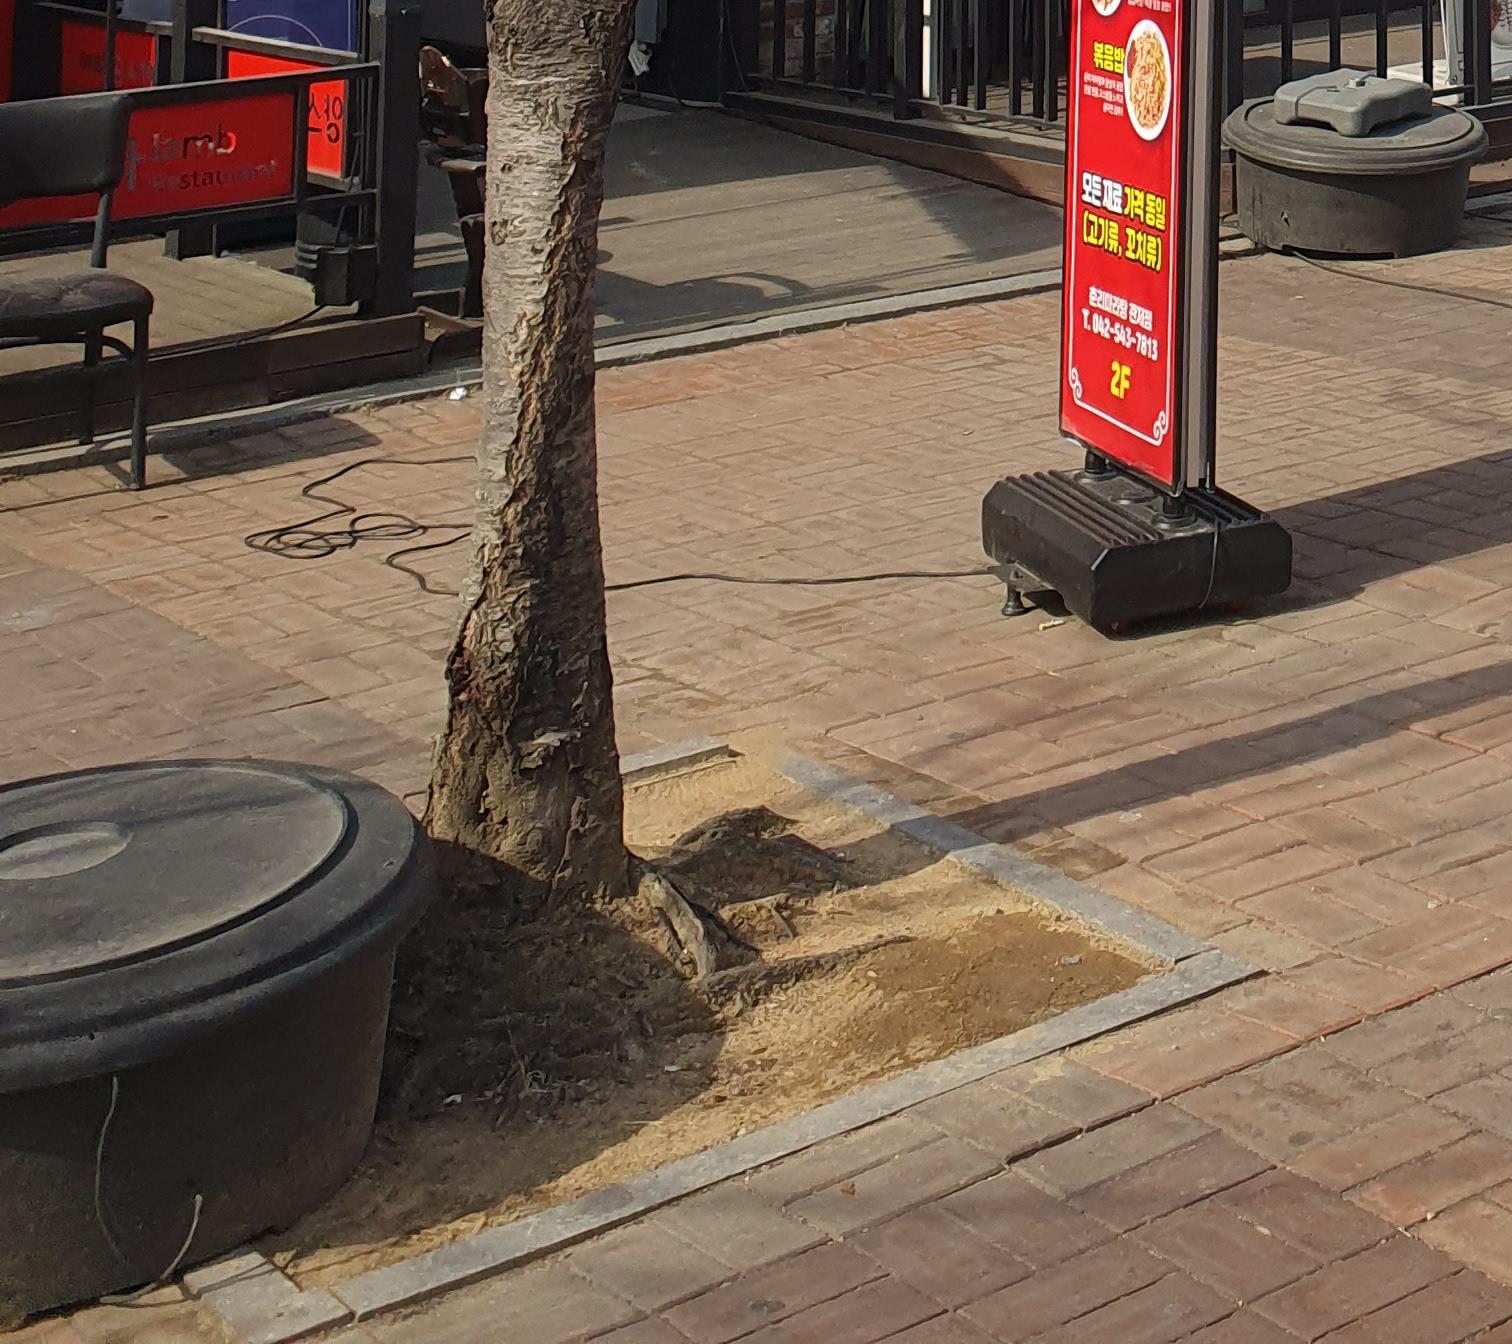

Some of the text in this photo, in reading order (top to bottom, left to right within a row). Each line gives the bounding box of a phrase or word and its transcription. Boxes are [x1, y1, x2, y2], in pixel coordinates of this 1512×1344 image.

[1124, 185, 1145, 223] 가격
[1145, 192, 1166, 231] 동일
[1110, 359, 1132, 400] 2F
